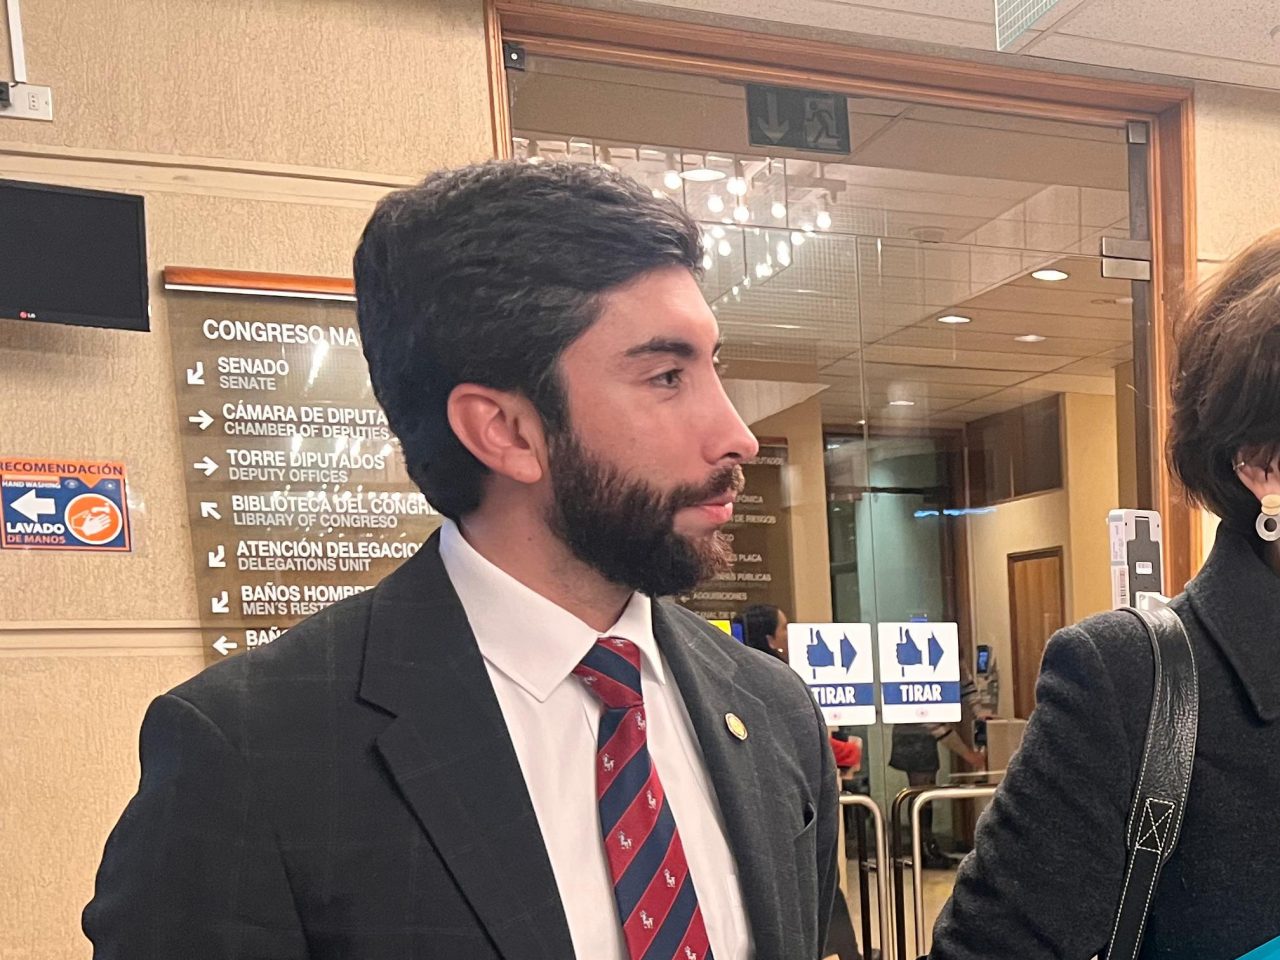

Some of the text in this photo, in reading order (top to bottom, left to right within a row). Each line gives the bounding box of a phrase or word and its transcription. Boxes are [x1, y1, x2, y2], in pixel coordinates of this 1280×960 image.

[203, 319, 359, 346] CONGRESO NA
[217, 357, 289, 376] SENADO
[219, 375, 277, 390] SENATE
[222, 400, 389, 425] CÁMARA DE DIPUTA
[224, 422, 390, 441] CHAMBER OF DEPUTIES
[226, 450, 385, 470] TORRE DIPUTADOS
[229, 467, 348, 483] DEPUTY OFFICES
[232, 494, 332, 513] BIBLIOTECA
[335, 497, 367, 514] DEL
[6, 522, 65, 535] LAVADO
[233, 513, 398, 528] LIBRARY OF CONGRESO
[7, 535, 66, 544] DE MANOS
[237, 538, 422, 559] ATENCIÓN DELEGACIO
[238, 557, 371, 572] DELEGATIONS UNIT
[241, 582, 375, 602] BAÑOS HOMB
[291, 602, 335, 615] REST
[246, 627, 288, 646] BAÑ
[811, 686, 856, 704] TIRAR
[900, 684, 942, 702] TIRAR
